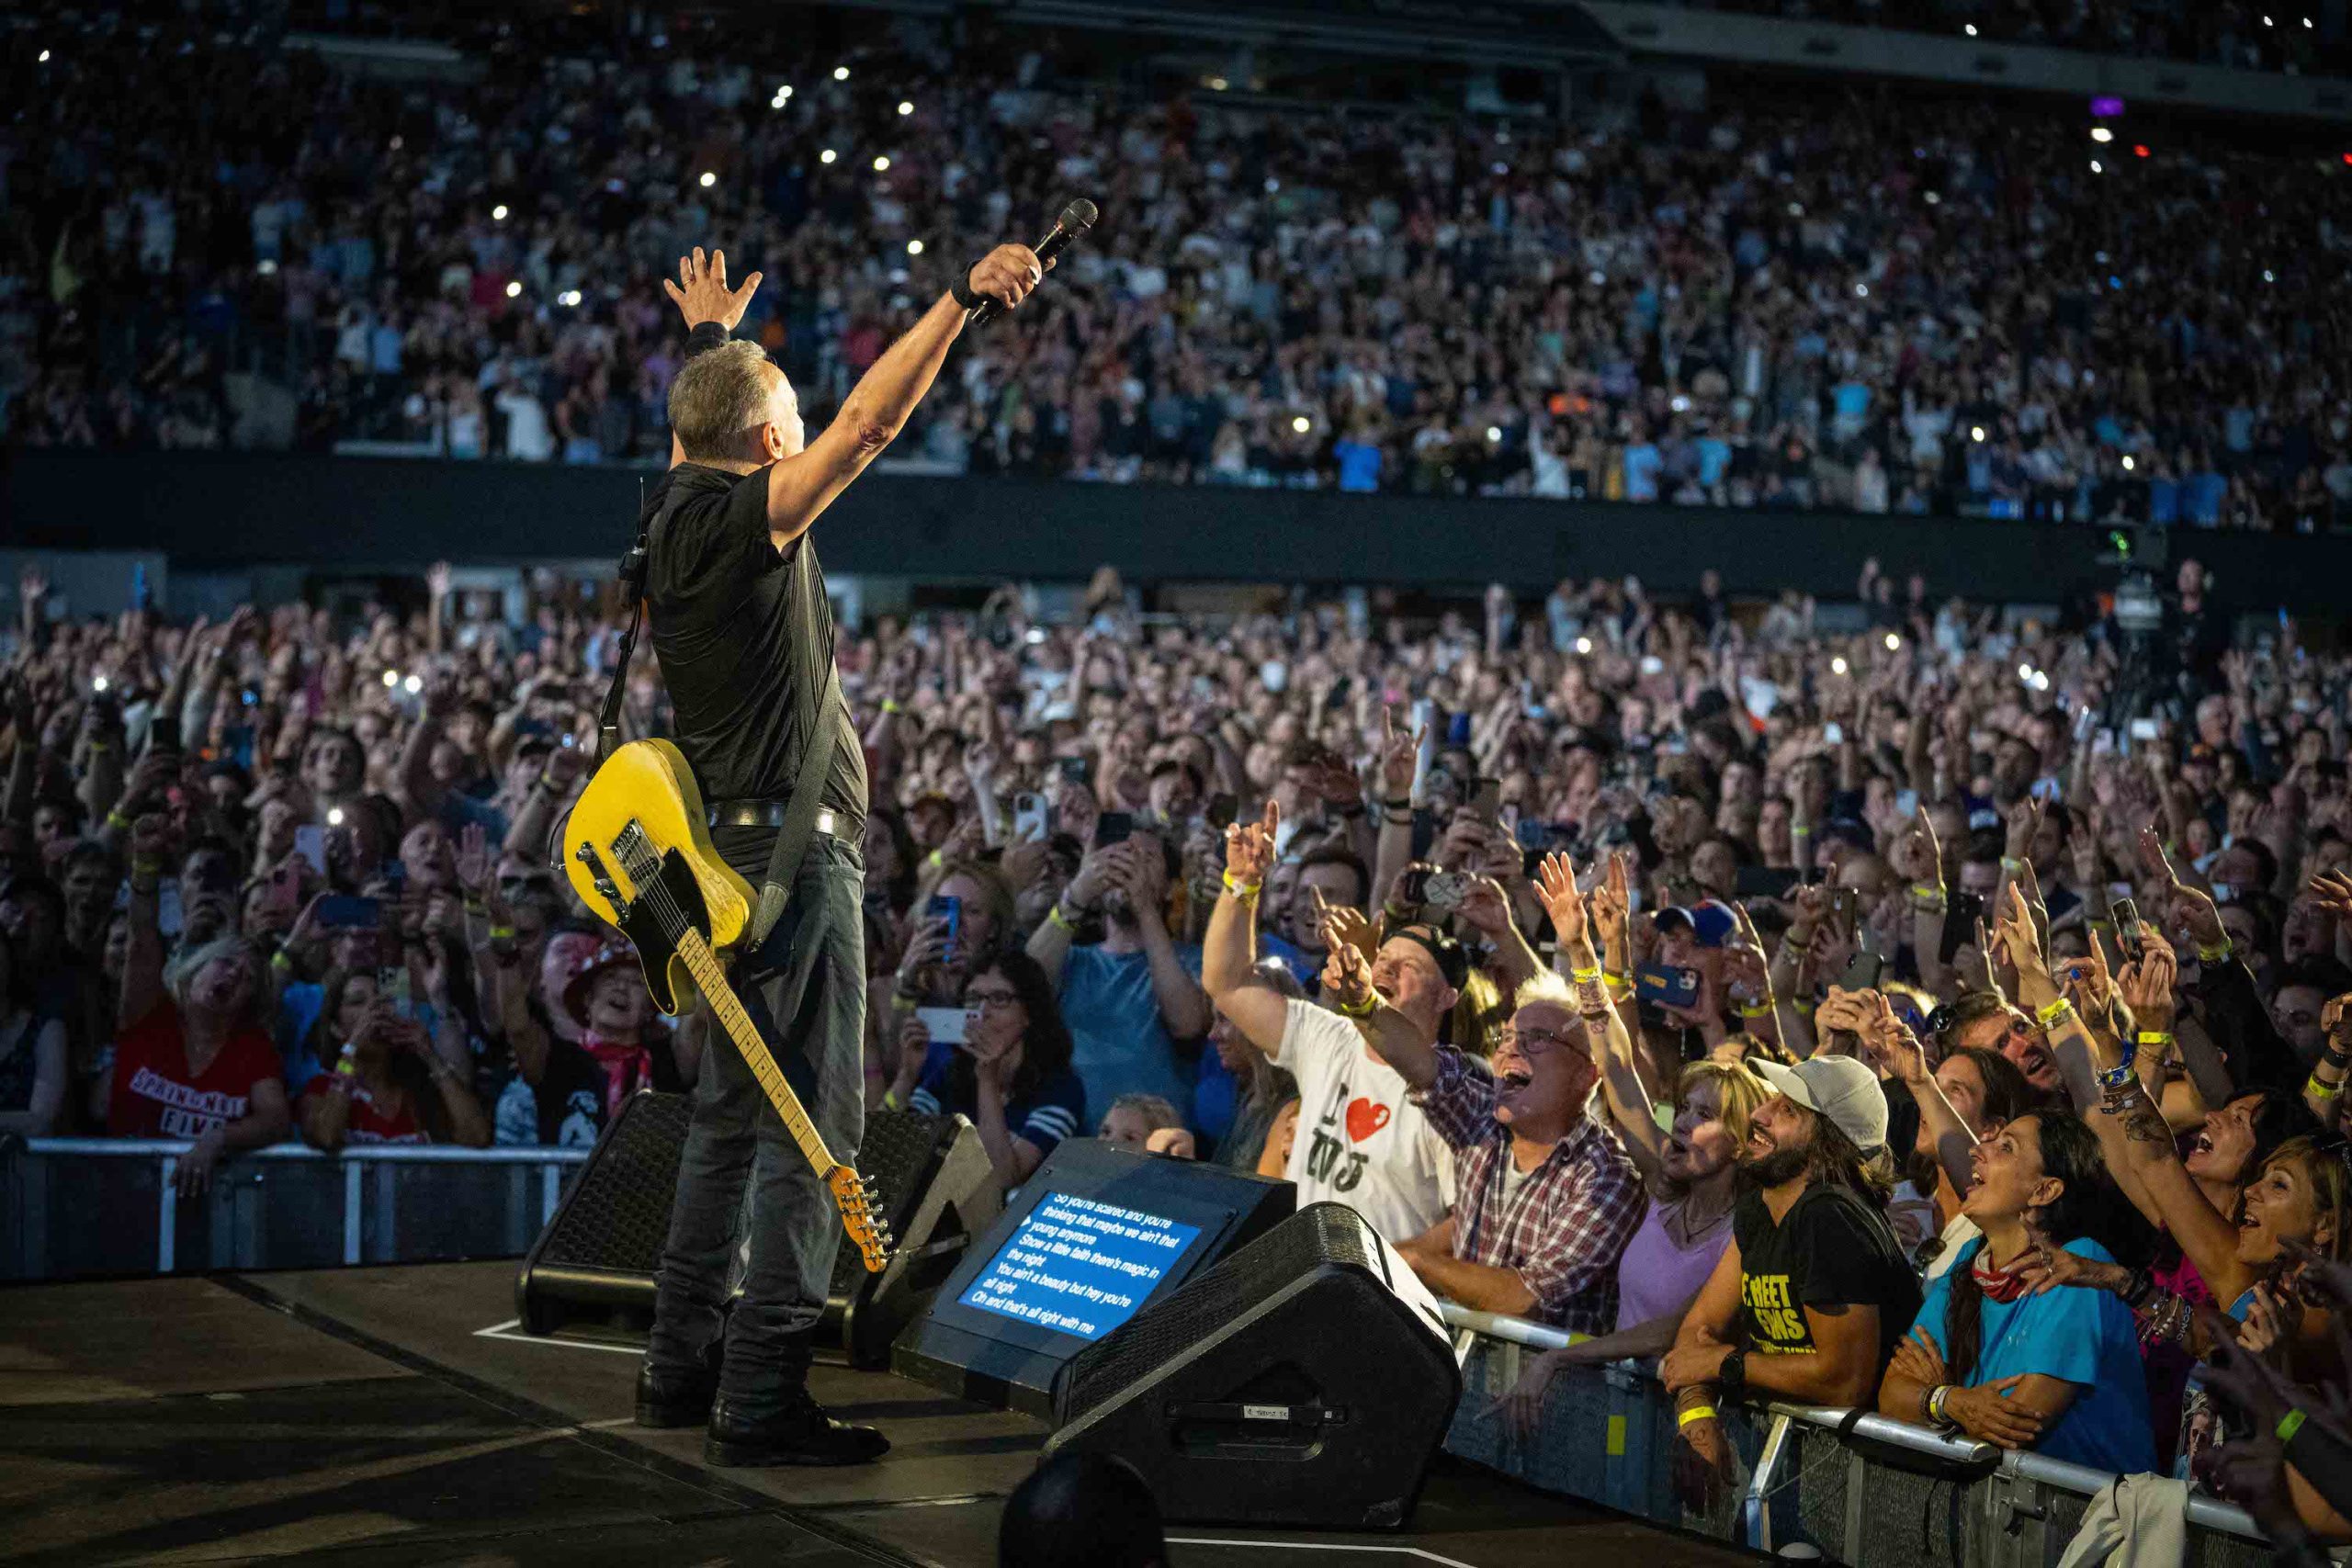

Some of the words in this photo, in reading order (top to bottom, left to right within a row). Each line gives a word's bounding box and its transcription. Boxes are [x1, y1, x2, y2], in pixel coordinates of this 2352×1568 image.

[1321, 1083, 1349, 1126] I
[1307, 1127, 1369, 1192] NJ
[1042, 1205, 1078, 1225] thinking
[1075, 1213, 1096, 1228] that
[1093, 1220, 1125, 1235] maybe
[1124, 1227, 1140, 1238] we
[1137, 1230, 1161, 1243] ain't
[1159, 1234, 1180, 1248] that
[1054, 1194, 1069, 1203] So
[1093, 1203, 1126, 1218] scared
[1124, 1210, 1144, 1222] and
[1028, 1222, 1059, 1237] young
[1057, 1228, 1097, 1246] anymore
[1006, 1247, 1023, 1259] the
[1021, 1252, 1047, 1267] night
[1019, 1234, 1046, 1249] Show
[1043, 1241, 1053, 1251] a
[1050, 1242, 1072, 1257] little
[1069, 1247, 1091, 1262] faith
[1089, 1252, 1123, 1269] there's
[1119, 1263, 1150, 1278] magic
[1148, 1267, 1160, 1280] in
[982, 1277, 999, 1288] all
[994, 1280, 1018, 1295] right
[997, 1261, 1012, 1276] You
[1012, 1267, 1033, 1281] ain't
[1030, 1273, 1040, 1283] a
[1038, 1273, 1071, 1293] beauty
[1069, 1281, 1087, 1296] but
[1084, 1285, 1104, 1303] hey
[1100, 1292, 1133, 1308] you're
[971, 1291, 987, 1303] Oh
[985, 1294, 1006, 1308] and
[1003, 1299, 1029, 1315] that's
[1026, 1305, 1041, 1319] all
[1037, 1310, 1062, 1325] right
[1059, 1316, 1080, 1331] with
[1076, 1322, 1095, 1335] me
